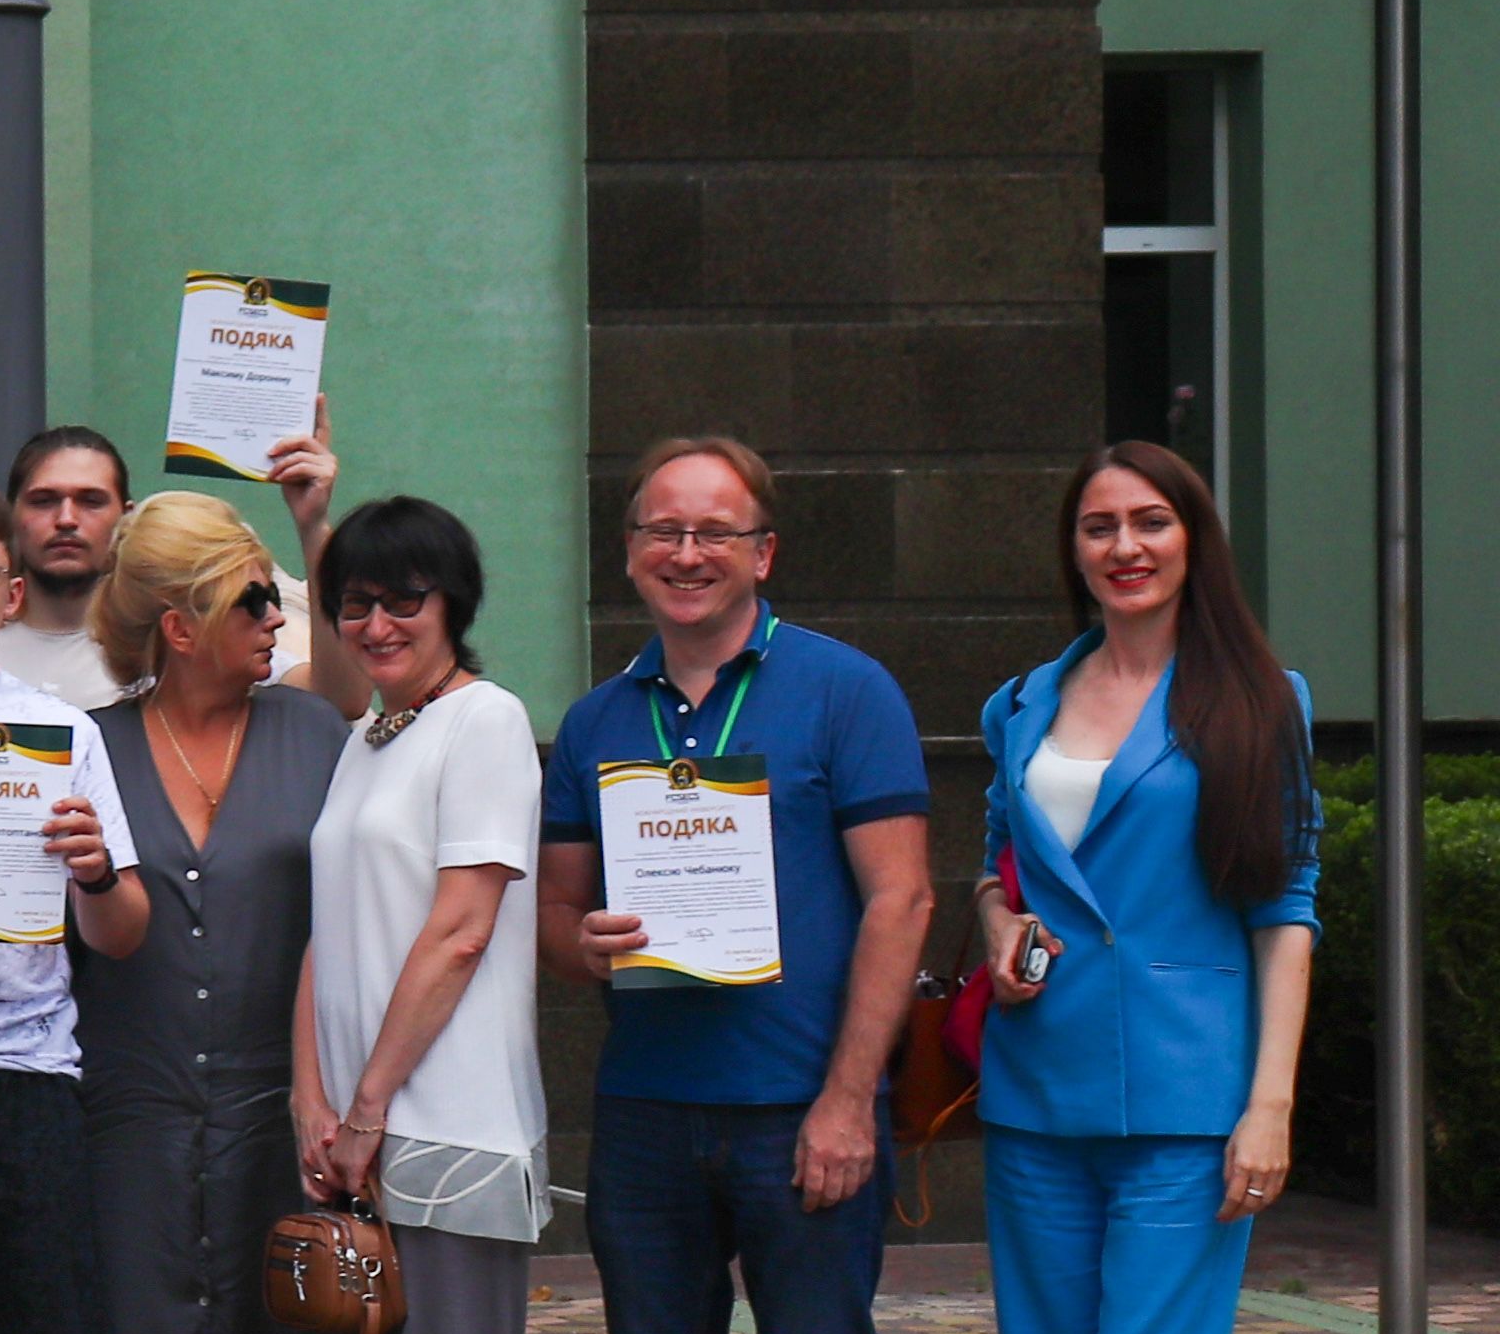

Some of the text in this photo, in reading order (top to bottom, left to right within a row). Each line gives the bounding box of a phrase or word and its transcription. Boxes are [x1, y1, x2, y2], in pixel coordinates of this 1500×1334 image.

[210, 327, 295, 350] ПОДЯКА
[639, 816, 737, 839] ПОДЯКА
[683, 864, 739, 876] Чебанюку
